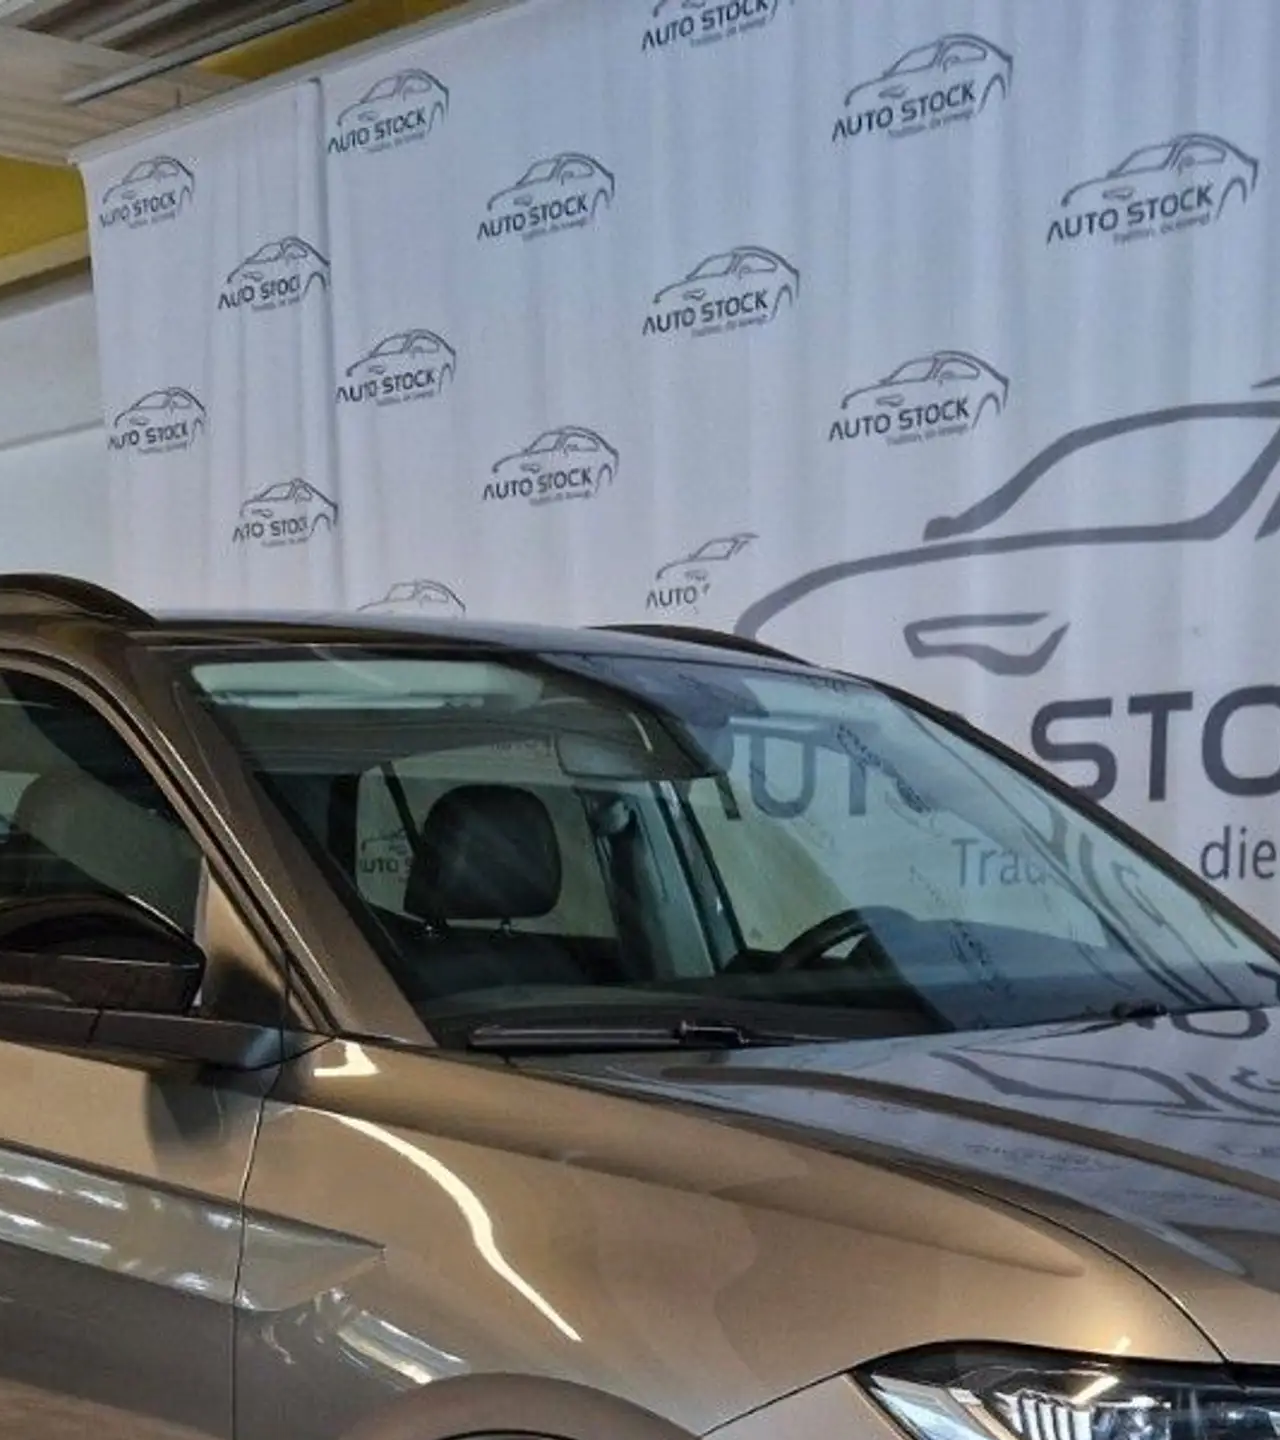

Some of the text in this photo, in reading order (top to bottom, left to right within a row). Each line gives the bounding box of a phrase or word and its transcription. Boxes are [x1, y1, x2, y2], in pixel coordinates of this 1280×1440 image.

[642, 16, 695, 50] AUTO
[700, 0, 768, 31] STOCK
[374, 106, 427, 141] STOCK
[832, 106, 894, 142] AUTO
[901, 79, 976, 122] STOCK
[477, 213, 526, 240] AUTO
[529, 193, 589, 226] STOCK
[1046, 209, 1119, 244] AUTO
[1127, 181, 1214, 227] STOCK
[642, 307, 697, 336] AUTO
[701, 288, 768, 323] STOCK
[829, 413, 891, 442] AUTO
[898, 396, 970, 431] STOCK
[483, 478, 534, 500] AUTO
[536, 466, 593, 493] STOCK
[646, 585, 699, 609] AUTO
[1200, 824, 1277, 881] die
